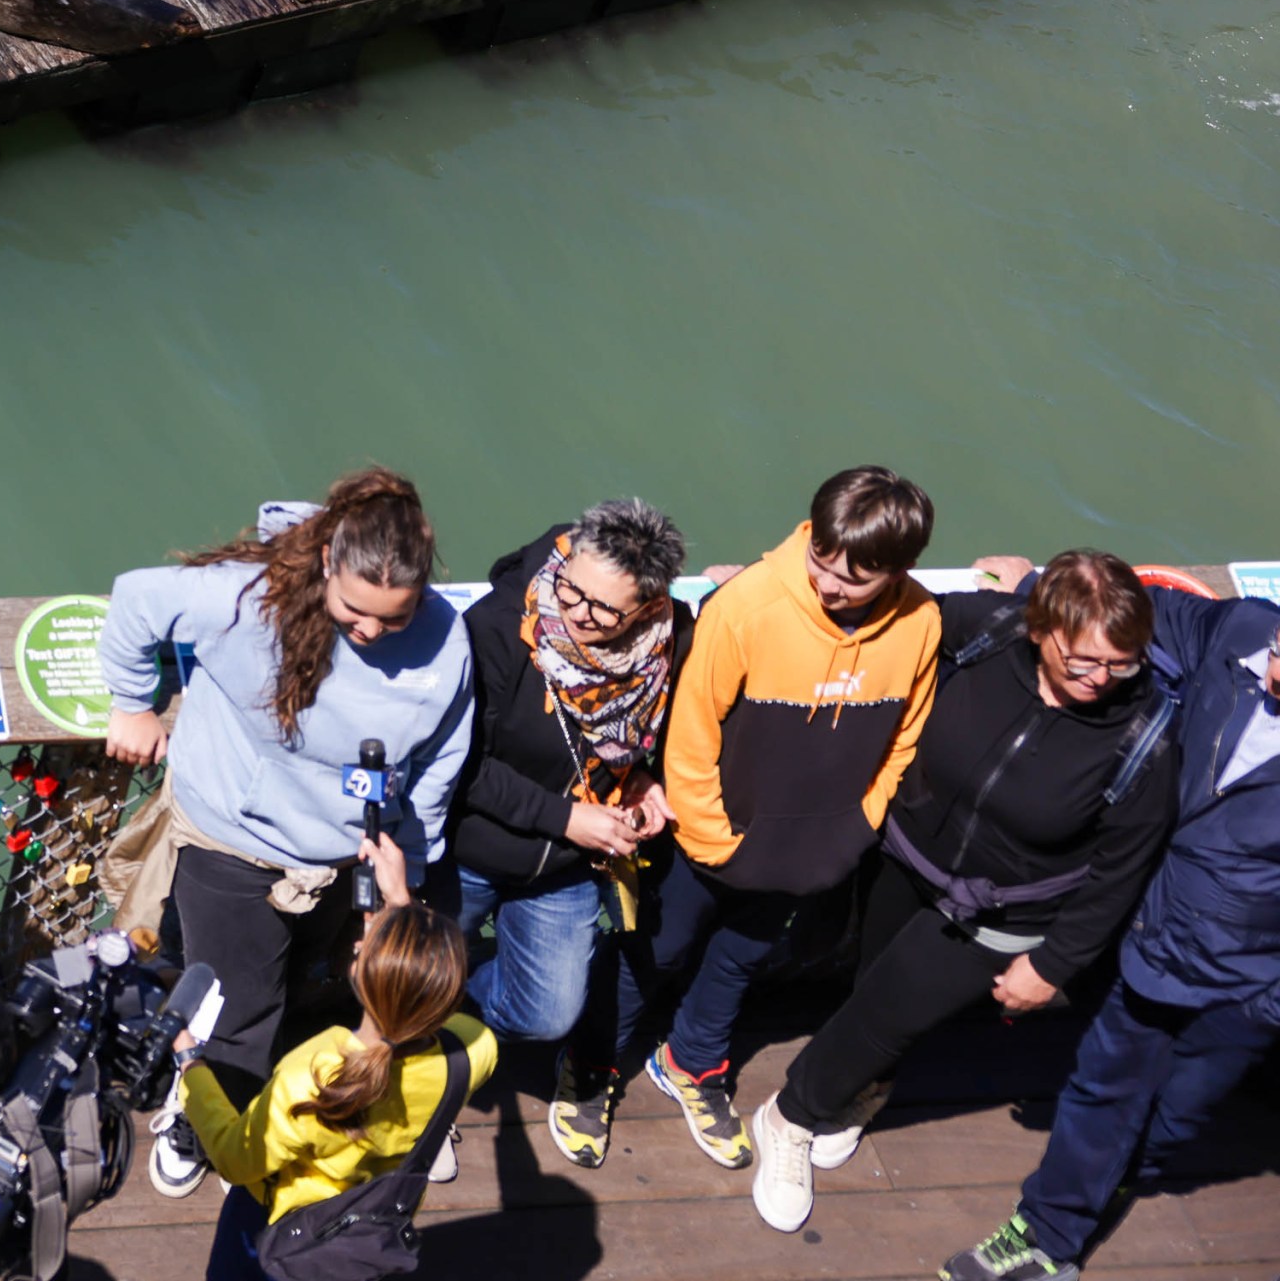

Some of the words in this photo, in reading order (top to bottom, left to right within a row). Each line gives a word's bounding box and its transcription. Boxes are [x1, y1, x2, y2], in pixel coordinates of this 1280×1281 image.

[52, 617, 94, 629] Looking
[57, 631, 93, 641] unique
[26, 649, 52, 660] Text
[53, 647, 96, 659] GIFT39
